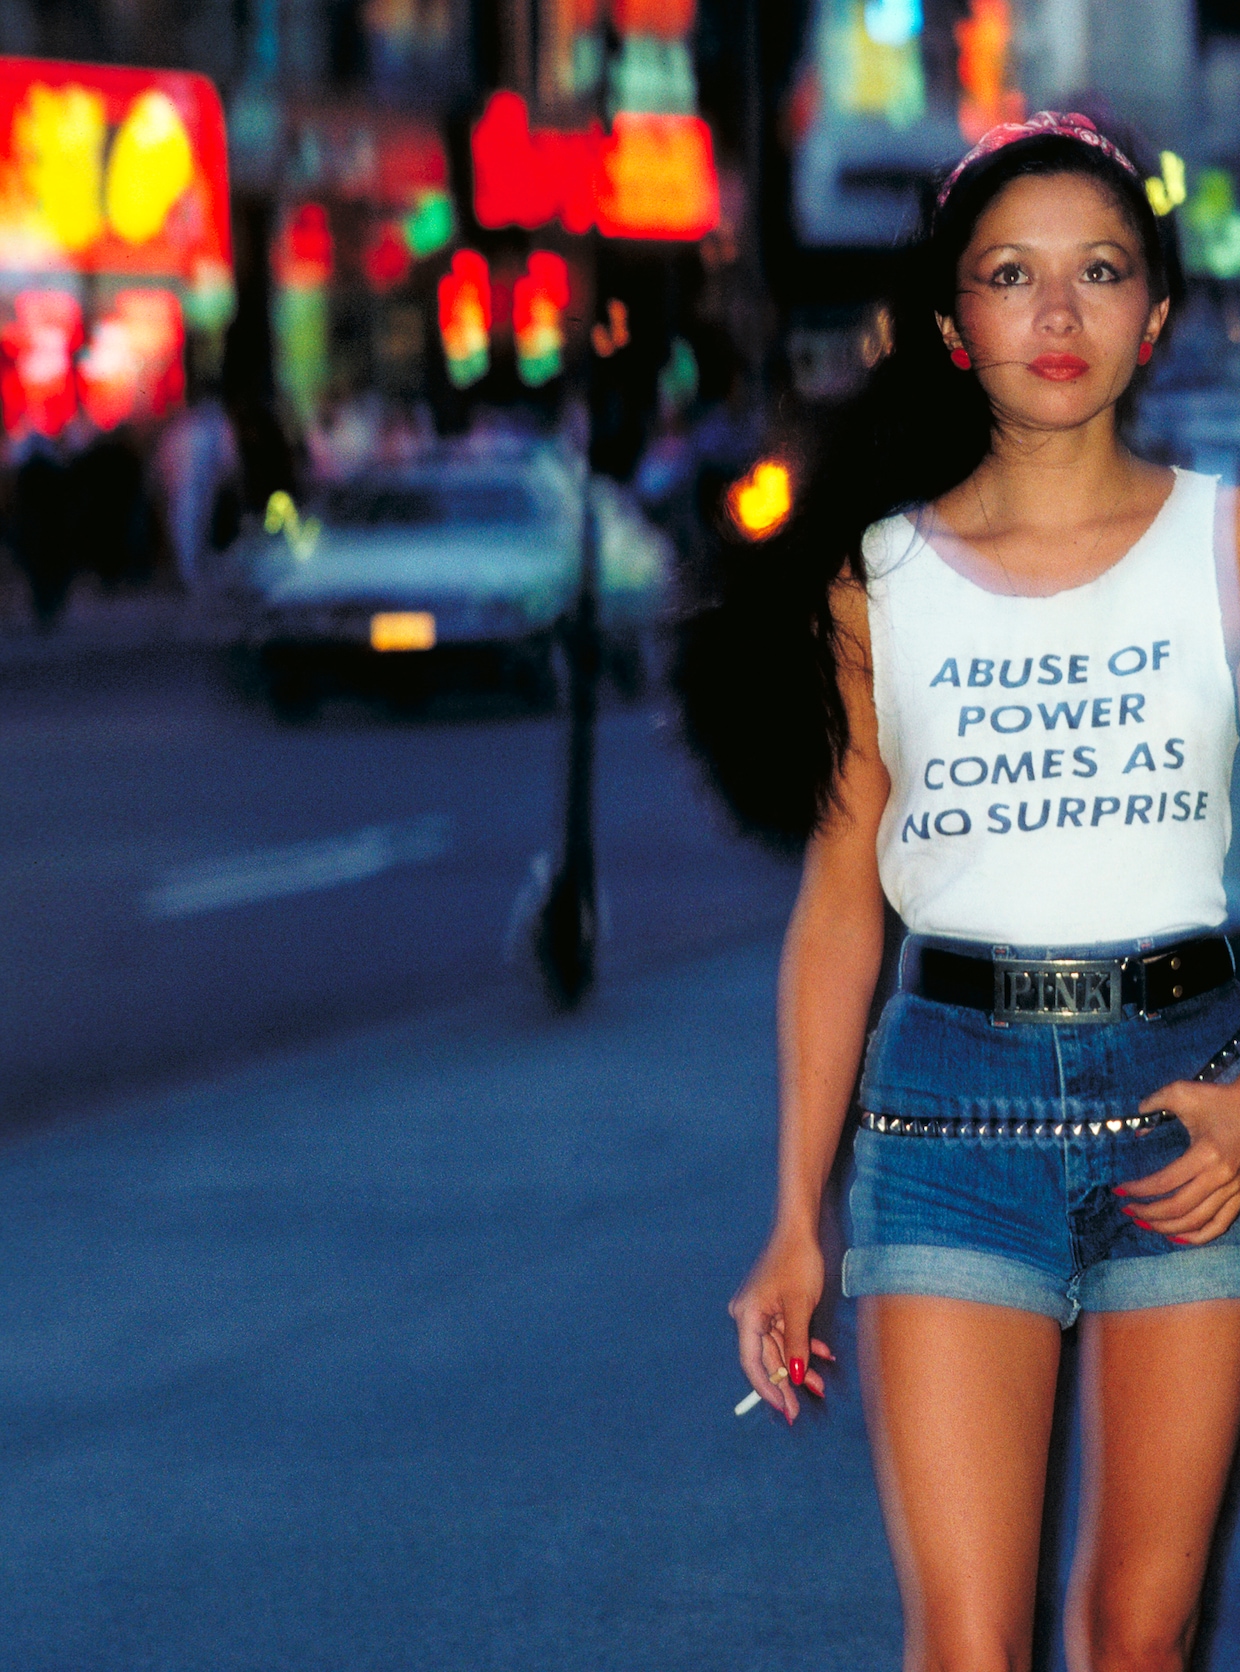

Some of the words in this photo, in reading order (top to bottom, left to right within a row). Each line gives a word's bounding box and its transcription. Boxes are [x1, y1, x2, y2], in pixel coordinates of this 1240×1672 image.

[929, 654, 1090, 689] ABUSE
[1107, 639, 1171, 677] OF
[957, 692, 1146, 737] POWER
[923, 745, 1098, 790] COMES
[1122, 737, 1185, 775] AS
[901, 808, 972, 843] NO
[987, 790, 1209, 834] SURPRISE
[1007, 971, 1109, 1012] PINK
